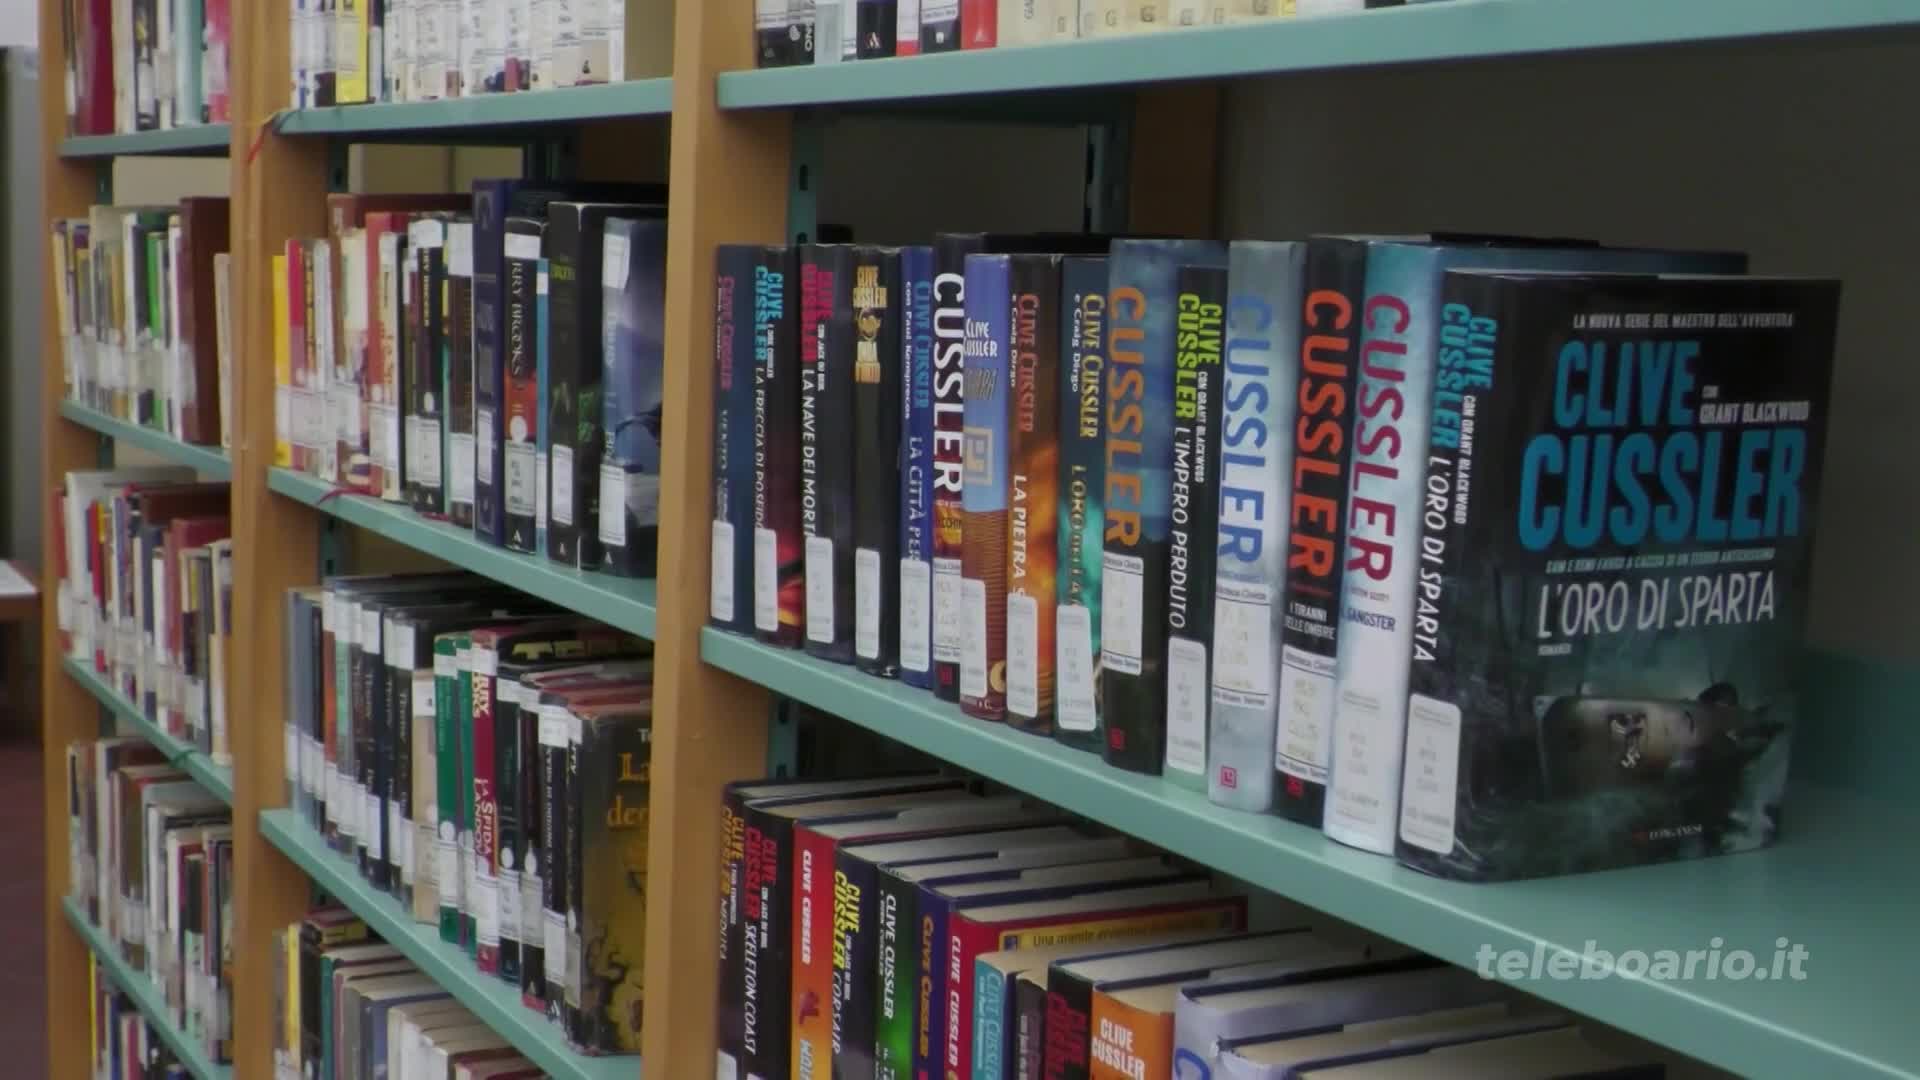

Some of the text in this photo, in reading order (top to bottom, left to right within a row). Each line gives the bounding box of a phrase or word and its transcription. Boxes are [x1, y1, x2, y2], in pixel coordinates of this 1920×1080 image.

[511, 262, 523, 299] RRY
[755, 266, 768, 361] CUSSLER
[767, 273, 783, 320] CLIVE
[1071, 308, 1082, 347] Craig
[1573, 314, 1587, 329] LA
[1588, 314, 1621, 329] NUOVA
[1652, 313, 1670, 328] DEL
[1671, 313, 1716, 328] MAESTRO
[914, 281, 931, 409] CLIVE CUSSLER
[965, 318, 990, 339] CLIVE
[1018, 293, 1040, 433] CLIVE CUSSLER
[1071, 353, 1082, 392] Dirgo
[1080, 294, 1105, 438] CLIVE CUSSLER
[1175, 293, 1200, 419] CUSSLER
[1198, 303, 1222, 366] CLIVE
[1431, 303, 1471, 449] CUSSLER
[1467, 316, 1497, 391] CLIVE
[803, 369, 816, 390] LA
[803, 396, 816, 441] NAVE
[933, 272, 964, 492] CUSSLER
[1104, 286, 1145, 548] CUSSLER
[1195, 371, 1208, 483] CON GRANT BLACKWOOD
[1553, 338, 1700, 429] CLIVE
[1699, 401, 1811, 425] GRANT BLACKWOOD
[803, 445, 816, 473] DEI
[909, 436, 923, 460] LA
[1217, 294, 1273, 564] CUSSLER
[1289, 289, 1353, 578] CUSSLER
[1344, 294, 1411, 582] CUSSLER
[1453, 395, 1476, 525] CON GRANT BLACKWOOD
[909, 465, 926, 520] CITTÀ
[1013, 475, 1027, 502] LA
[1169, 427, 1191, 629] L'IMPERO PERDUTO
[1518, 428, 1808, 552] CUSSLER
[1012, 508, 1027, 578] PIETRA
[1413, 455, 1451, 662] L'ORO DI SPARTA
[1537, 571, 1776, 639] L'ORO DI SPARTA
[743, 826, 761, 922] CUSSLER
[801, 848, 812, 966] CLIVE CUSSLER
[832, 870, 848, 971] CUSSLER
[843, 883, 861, 934] CLIVE
[743, 922, 757, 1056] SKELETON COAST
[883, 893, 897, 1019] CLIVE CUSSLER
[948, 935, 962, 1067] CLIVE CUSSLER
[1092, 1039, 1146, 1080] CUSSLER
[1100, 1017, 1134, 1050] CLIVE
